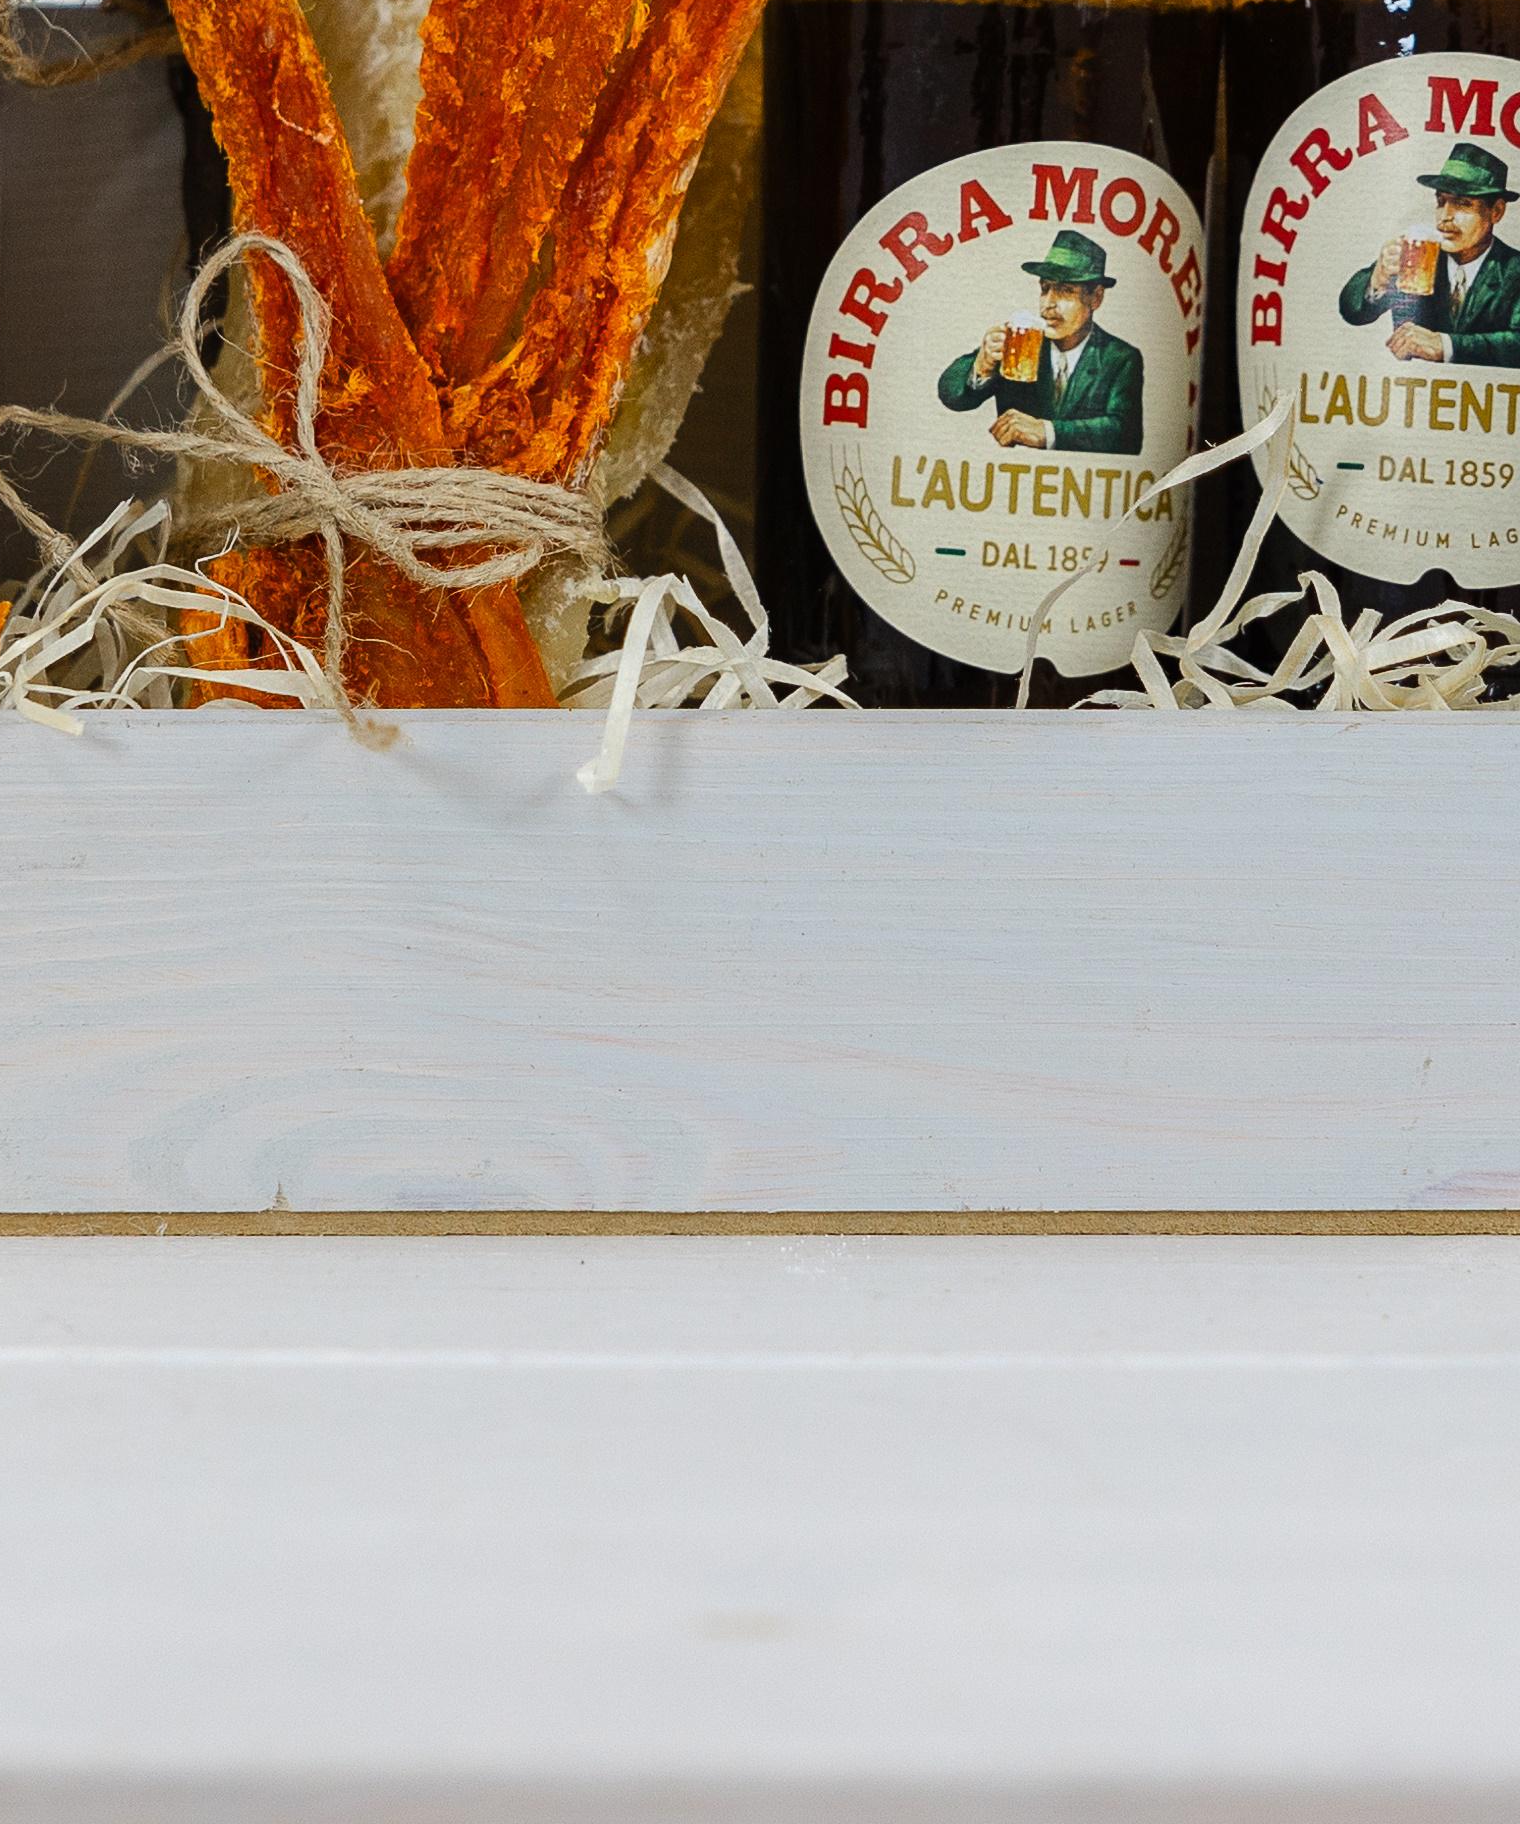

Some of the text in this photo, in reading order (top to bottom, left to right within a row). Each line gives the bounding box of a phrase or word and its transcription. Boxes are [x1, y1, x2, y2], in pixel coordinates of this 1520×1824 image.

[1251, 92, 1410, 347] BIRRA
[822, 163, 1202, 453] BIRRA MORE
[891, 454, 1173, 522] L'AUTENTICA
[1378, 454, 1516, 490] DAL 1859
[1335, 503, 1451, 549] PREMIUM
[982, 540, 1038, 570] DAL
[1070, 600, 1138, 634] LAGER
